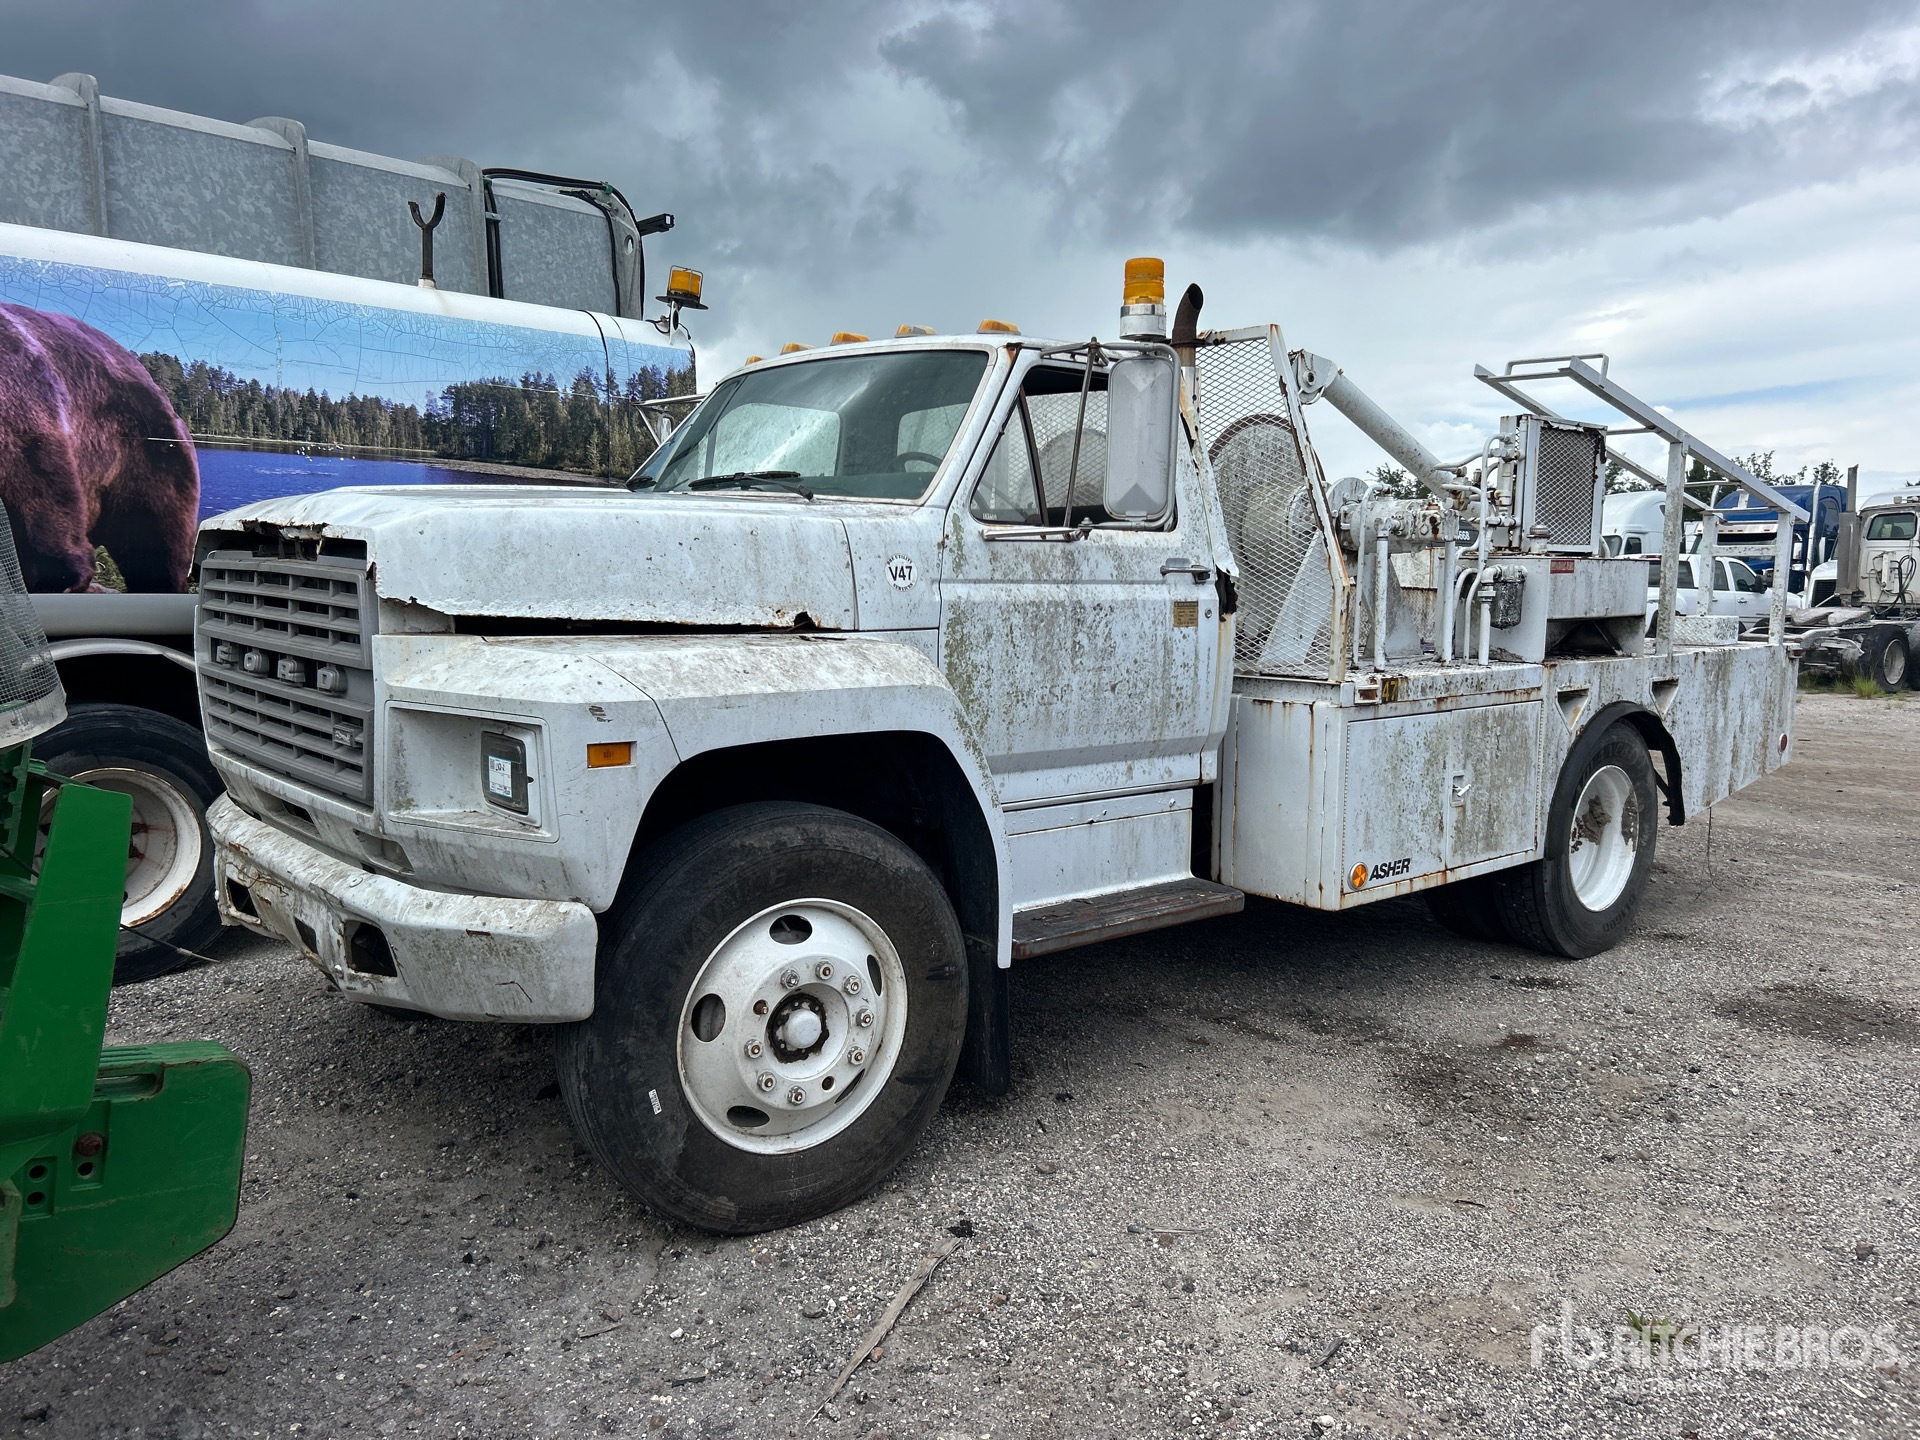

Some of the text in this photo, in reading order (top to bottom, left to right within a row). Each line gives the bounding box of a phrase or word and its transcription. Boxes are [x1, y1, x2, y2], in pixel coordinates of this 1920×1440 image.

[888, 565, 913, 582] V47
[216, 644, 348, 697] FORD
[1382, 680, 1398, 702] 47
[1369, 858, 1411, 881] ASHER
